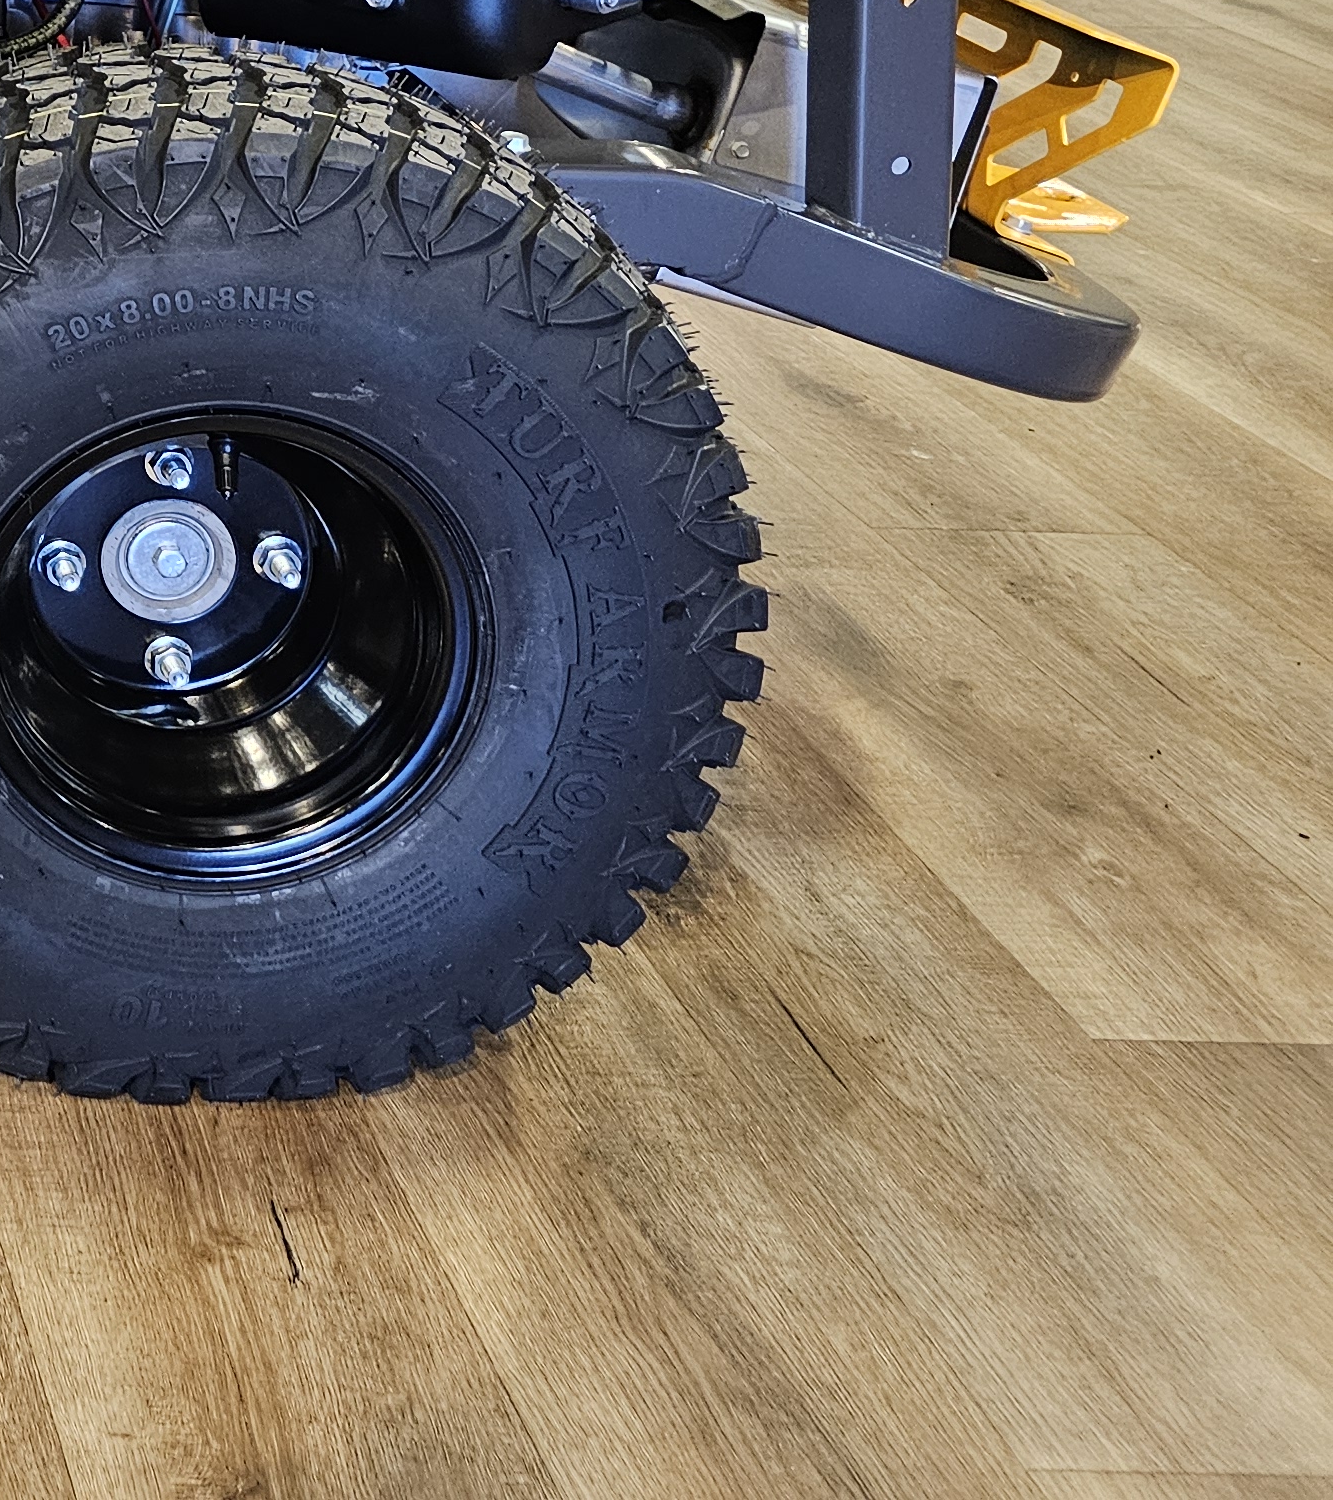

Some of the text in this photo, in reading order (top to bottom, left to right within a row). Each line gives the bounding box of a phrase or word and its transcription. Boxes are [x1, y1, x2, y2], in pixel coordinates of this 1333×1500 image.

[51, 350, 85, 371] NOT
[94, 335, 129, 353] FOR
[136, 317, 229, 340] HIGHWAY
[469, 358, 633, 553] TURF
[485, 582, 649, 874] ARMOR
